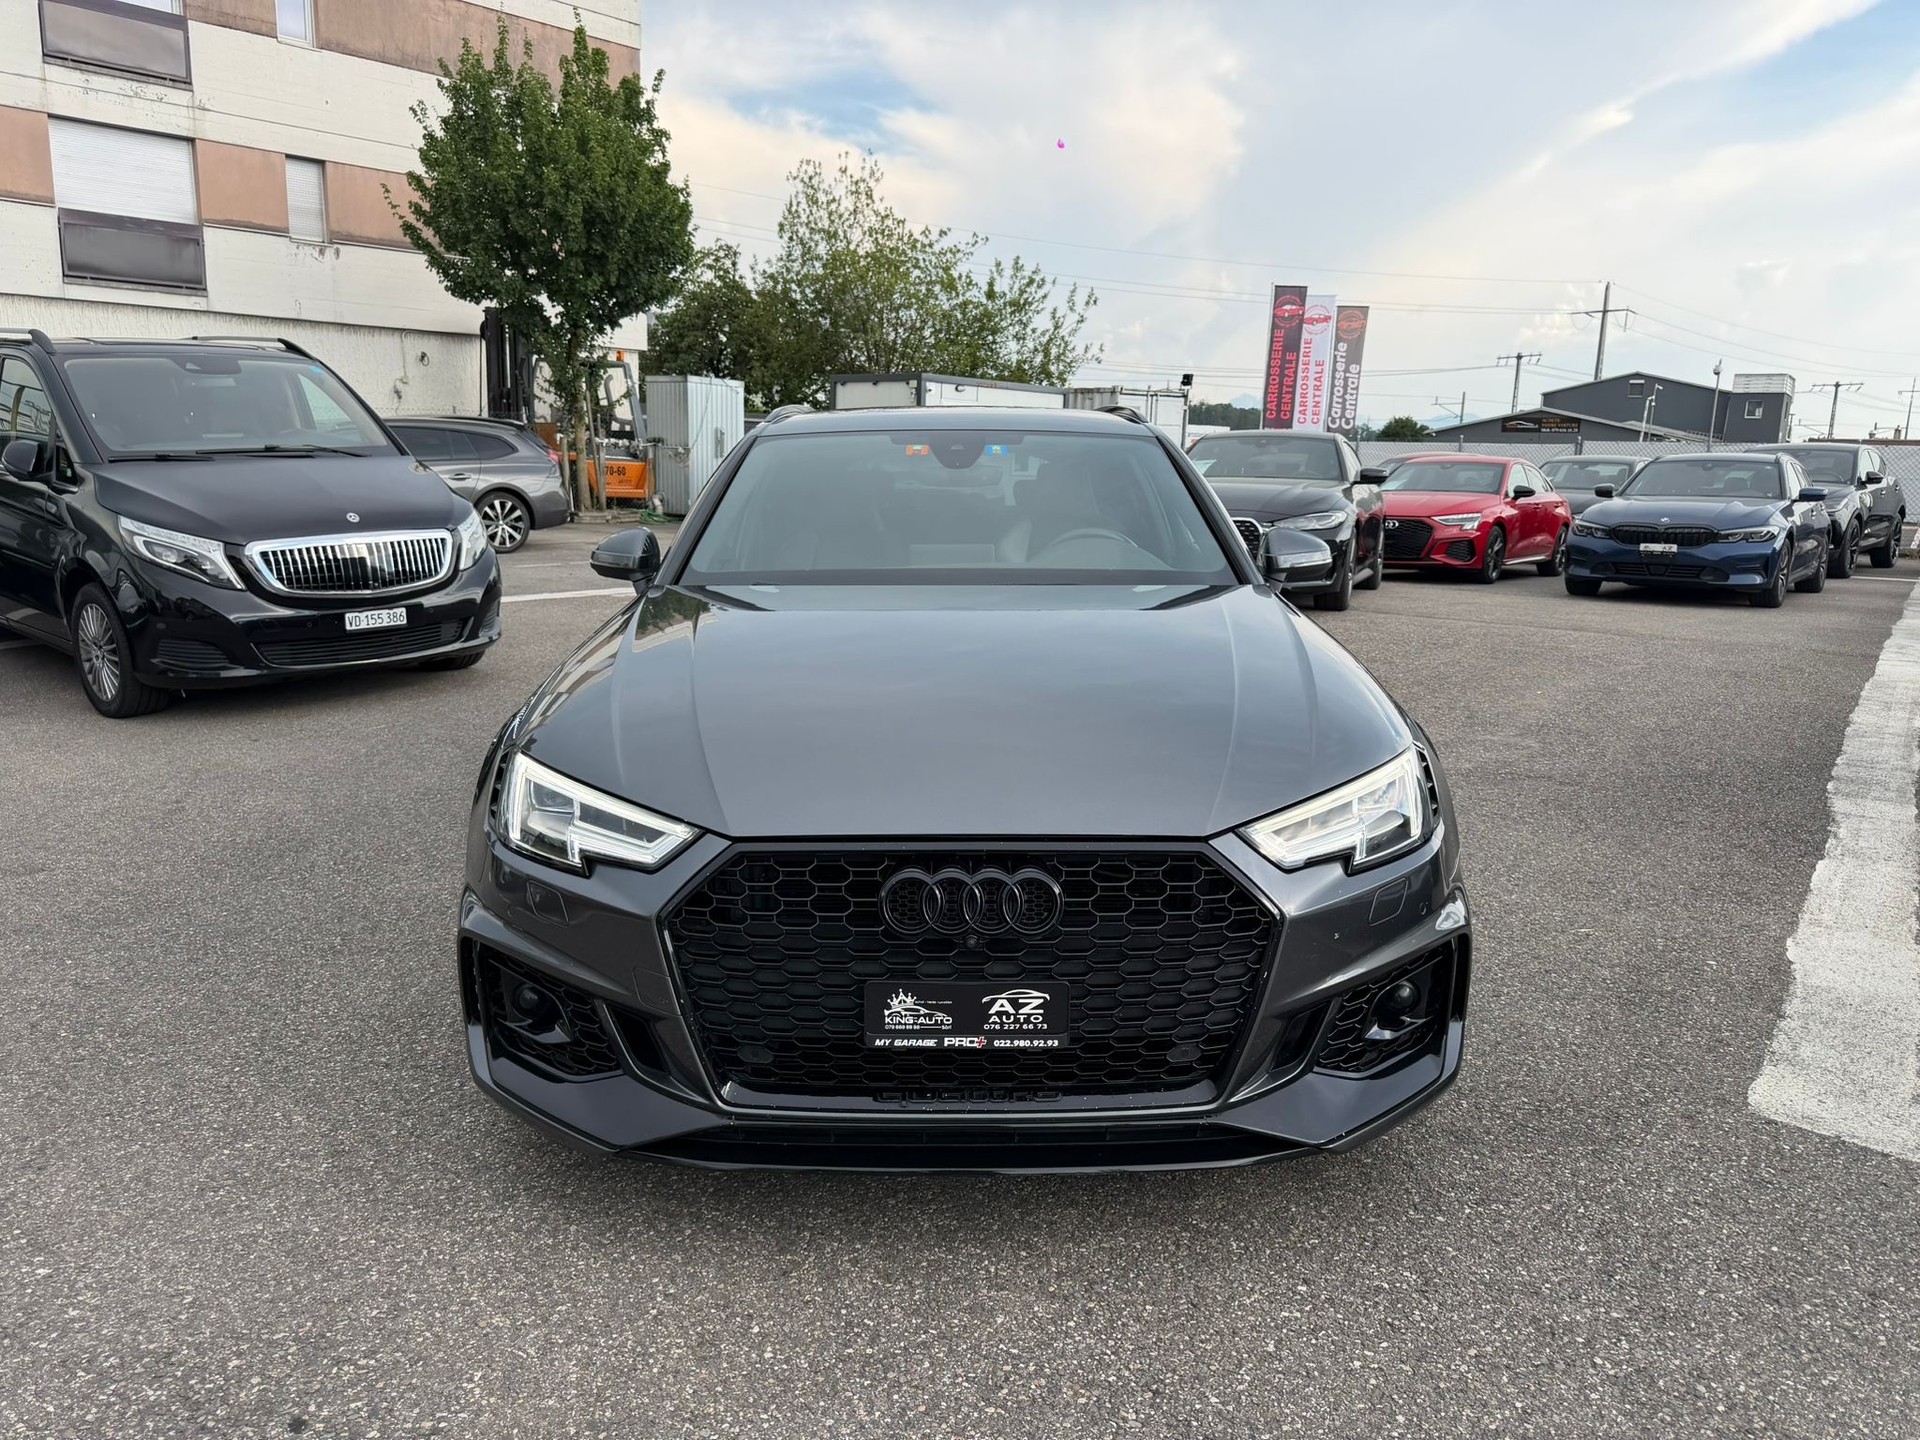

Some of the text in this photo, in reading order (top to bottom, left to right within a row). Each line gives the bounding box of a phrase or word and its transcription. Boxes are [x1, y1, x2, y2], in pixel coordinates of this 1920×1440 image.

[1266, 328, 1285, 419] CARROSSERIE
[1280, 352, 1297, 419] CENTRALE
[1297, 337, 1312, 425] CARROSSERIE
[1311, 360, 1325, 425] CENTRALE
[1327, 341, 1348, 429] Carrosserie
[1341, 364, 1360, 430] Centrale
[988, 998, 1044, 1014] AZ
[988, 1015, 1043, 1023] AUTO
[874, 1039, 892, 1047] MY
[894, 1039, 938, 1047] GARAGE
